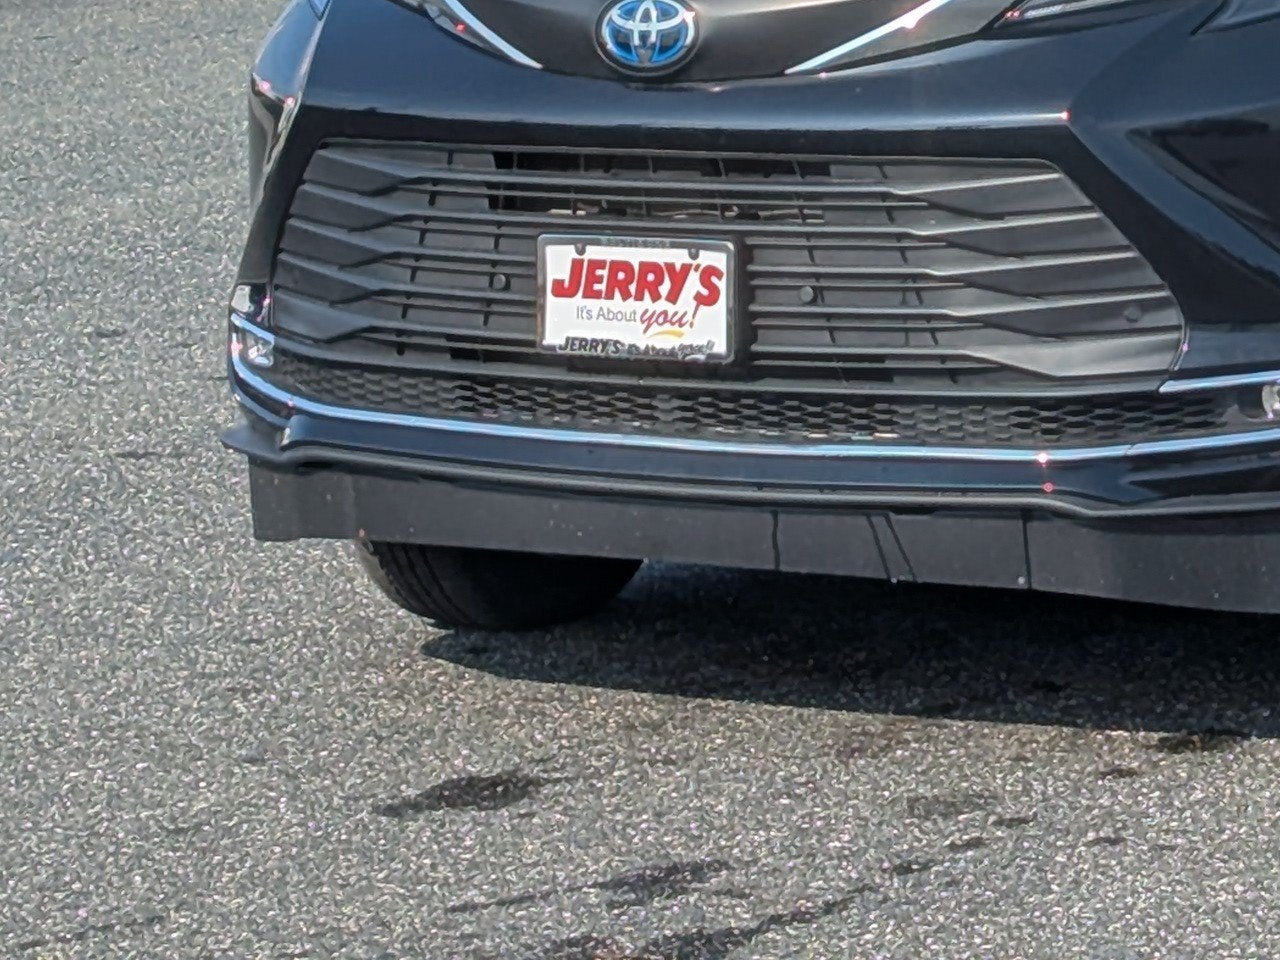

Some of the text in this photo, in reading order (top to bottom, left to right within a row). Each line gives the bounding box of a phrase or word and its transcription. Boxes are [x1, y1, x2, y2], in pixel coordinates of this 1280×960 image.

[551, 257, 725, 307] JERRY'S
[576, 303, 700, 335] It's About you!
[558, 336, 624, 355] JERRY'S
